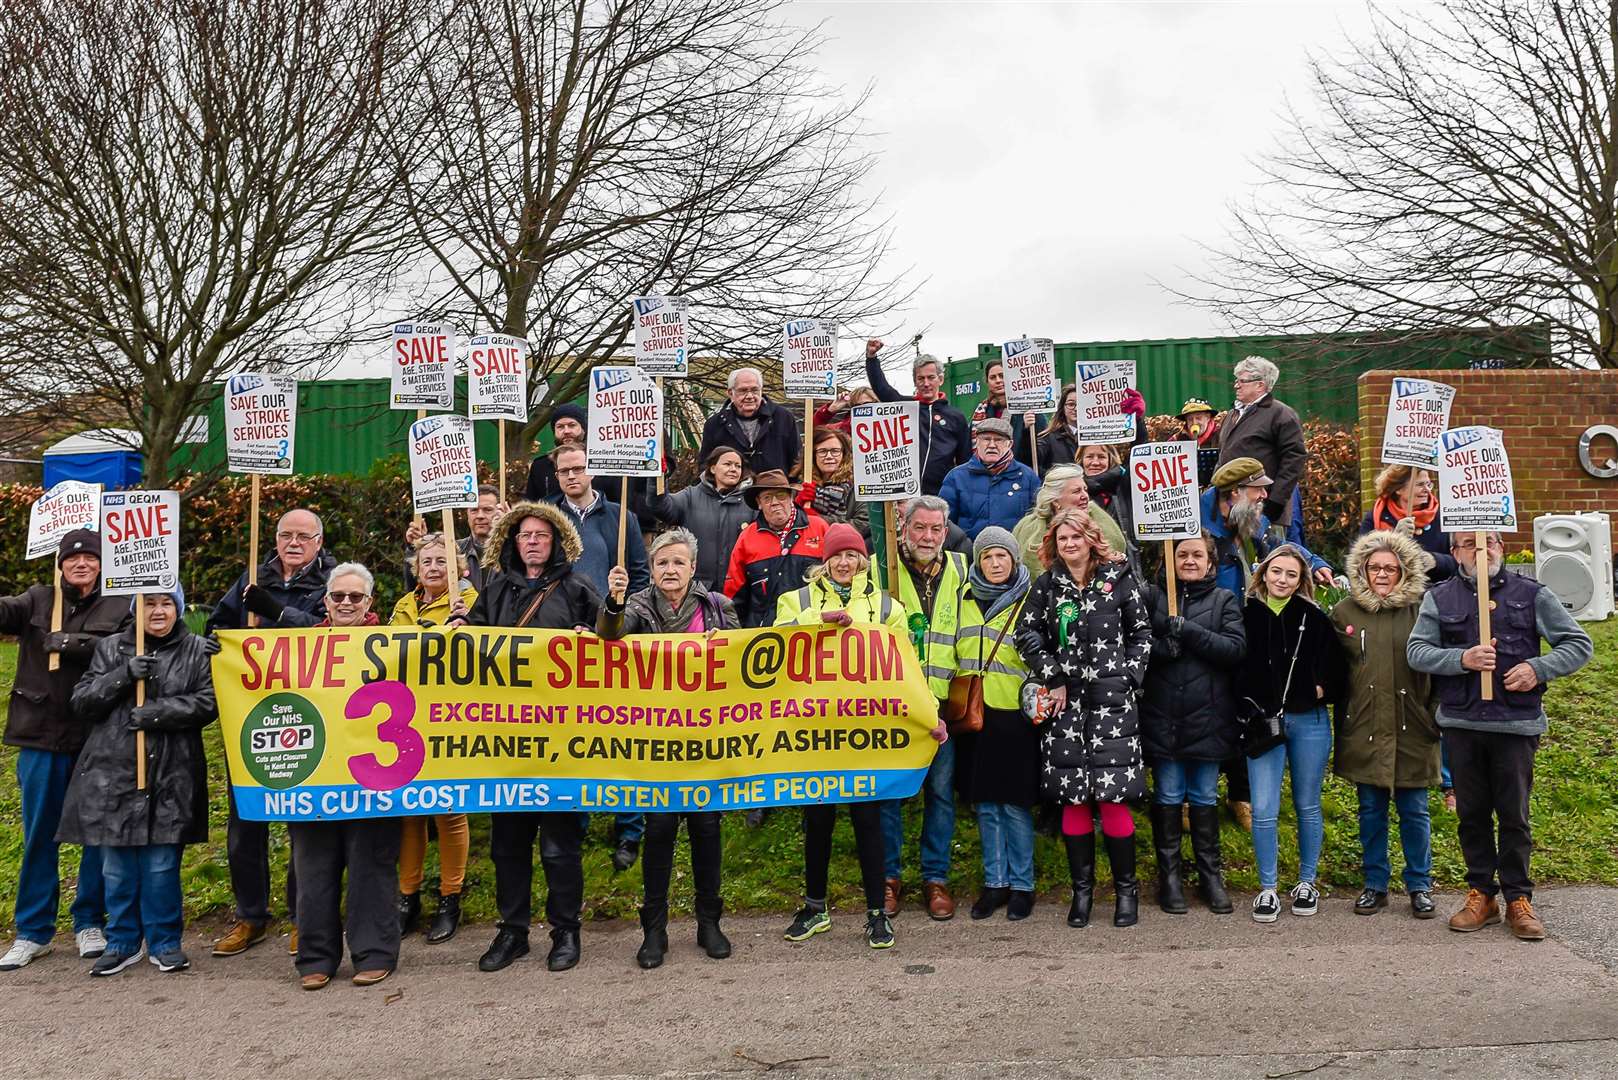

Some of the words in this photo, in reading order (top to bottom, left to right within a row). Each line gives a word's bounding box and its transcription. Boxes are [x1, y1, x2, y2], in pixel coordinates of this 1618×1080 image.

[640, 314, 660, 328] SAVE
[662, 312, 680, 324] OUR
[416, 326, 440, 334] QEQM
[651, 324, 684, 338] STROKE
[492, 337, 514, 346] QEQM
[643, 336, 683, 352] SERVICES
[788, 337, 811, 350] SAVE
[814, 336, 830, 346] OUR
[396, 336, 448, 366] SAVE
[676, 349, 684, 364] 3
[801, 348, 834, 360] STROKE
[419, 363, 443, 372] STROKE
[472, 348, 520, 376] SAVE
[791, 360, 832, 373] SERVICES
[1007, 356, 1029, 369] SAVE
[1030, 352, 1046, 364] OUR
[408, 373, 445, 384] MATERNITY
[1020, 363, 1051, 378] STROKE
[496, 375, 518, 384] STROKE
[826, 372, 833, 386] 3
[1012, 376, 1051, 392] SERVICES
[1081, 380, 1107, 394] SAVE
[1109, 377, 1128, 390] OUR
[415, 383, 446, 393] SERVICES
[486, 384, 518, 395] MATERNITY
[1046, 386, 1052, 400] 3
[230, 395, 258, 410] SAVE
[262, 394, 285, 408] OUR
[493, 394, 520, 403] SERVICES
[596, 391, 626, 408] SAVE
[630, 390, 654, 404] OUR
[1096, 390, 1129, 405] STROK
[1396, 399, 1423, 410] SAVE
[1426, 400, 1443, 412] OUR
[246, 409, 290, 424] STROKE
[612, 406, 658, 423] STROKE
[876, 406, 904, 416] QEQM
[1086, 404, 1120, 419] SERVIC
[1408, 412, 1444, 426] STROKE
[234, 424, 288, 440] SERVICES
[599, 423, 656, 441] SERVICES
[856, 415, 913, 453] SAVE
[1396, 426, 1442, 439] SERVICES
[278, 440, 288, 457] 3
[416, 436, 441, 455] SAVE
[444, 433, 465, 446] OUR
[646, 440, 656, 458] 3
[1155, 446, 1182, 454] QEQM
[1579, 424, 1618, 478] Q
[430, 446, 471, 465] STROKE
[882, 446, 909, 461] STROKE
[1445, 450, 1479, 468] SAVE
[1482, 448, 1502, 462] OUR
[422, 461, 471, 483] SERVICES
[872, 457, 910, 474] MATERNITY
[1135, 454, 1192, 492] SAVE
[1464, 464, 1508, 480] STROKE
[464, 476, 472, 492] 3
[880, 468, 912, 484] SERVICES
[1162, 486, 1188, 500] STROKE
[1451, 480, 1508, 499] SERVICES
[37, 496, 64, 515] SAVE
[67, 494, 90, 504] OUR
[129, 495, 161, 504] QEQM
[1152, 496, 1189, 512] MATERNITY
[1501, 496, 1509, 514] 3
[51, 503, 96, 520] STROKE
[1160, 507, 1192, 522] SERVICES
[40, 513, 93, 535] SERVICES
[106, 504, 172, 544] SAVE
[133, 537, 166, 550] STROKE
[121, 548, 166, 565] MATERNITY
[130, 560, 169, 575] SERVICES
[241, 634, 350, 690] SAVE
[361, 632, 533, 687] STROKE
[547, 636, 729, 692] SERVICE
[741, 628, 904, 690] @QEQM
[272, 704, 293, 714] Save
[429, 703, 569, 724] EXCELLENT
[577, 705, 713, 728] HOSPITALS
[719, 703, 763, 725] FOR
[770, 699, 829, 719] EAST
[837, 698, 908, 718] KENT:
[263, 715, 281, 727] Our
[282, 713, 303, 724] NHS
[252, 727, 312, 750] STOP
[344, 680, 426, 791] 3
[428, 735, 559, 762] THANET,
[567, 733, 764, 762] CANTERBURY,
[771, 728, 911, 757] ASHFORD
[256, 755, 268, 763] Cuts
[270, 754, 282, 762] and
[283, 753, 308, 761] Closures
[272, 762, 286, 770] Kent
[287, 762, 298, 770] and
[270, 770, 294, 780] Medway
[265, 792, 318, 816] NHS
[324, 790, 393, 813] CUTS
[402, 784, 469, 809] COST
[479, 783, 550, 808] LIVES
[581, 785, 668, 808] LISTEN
[679, 785, 711, 808] TO
[720, 780, 766, 805] THE
[774, 775, 877, 801] PEOPLE!
